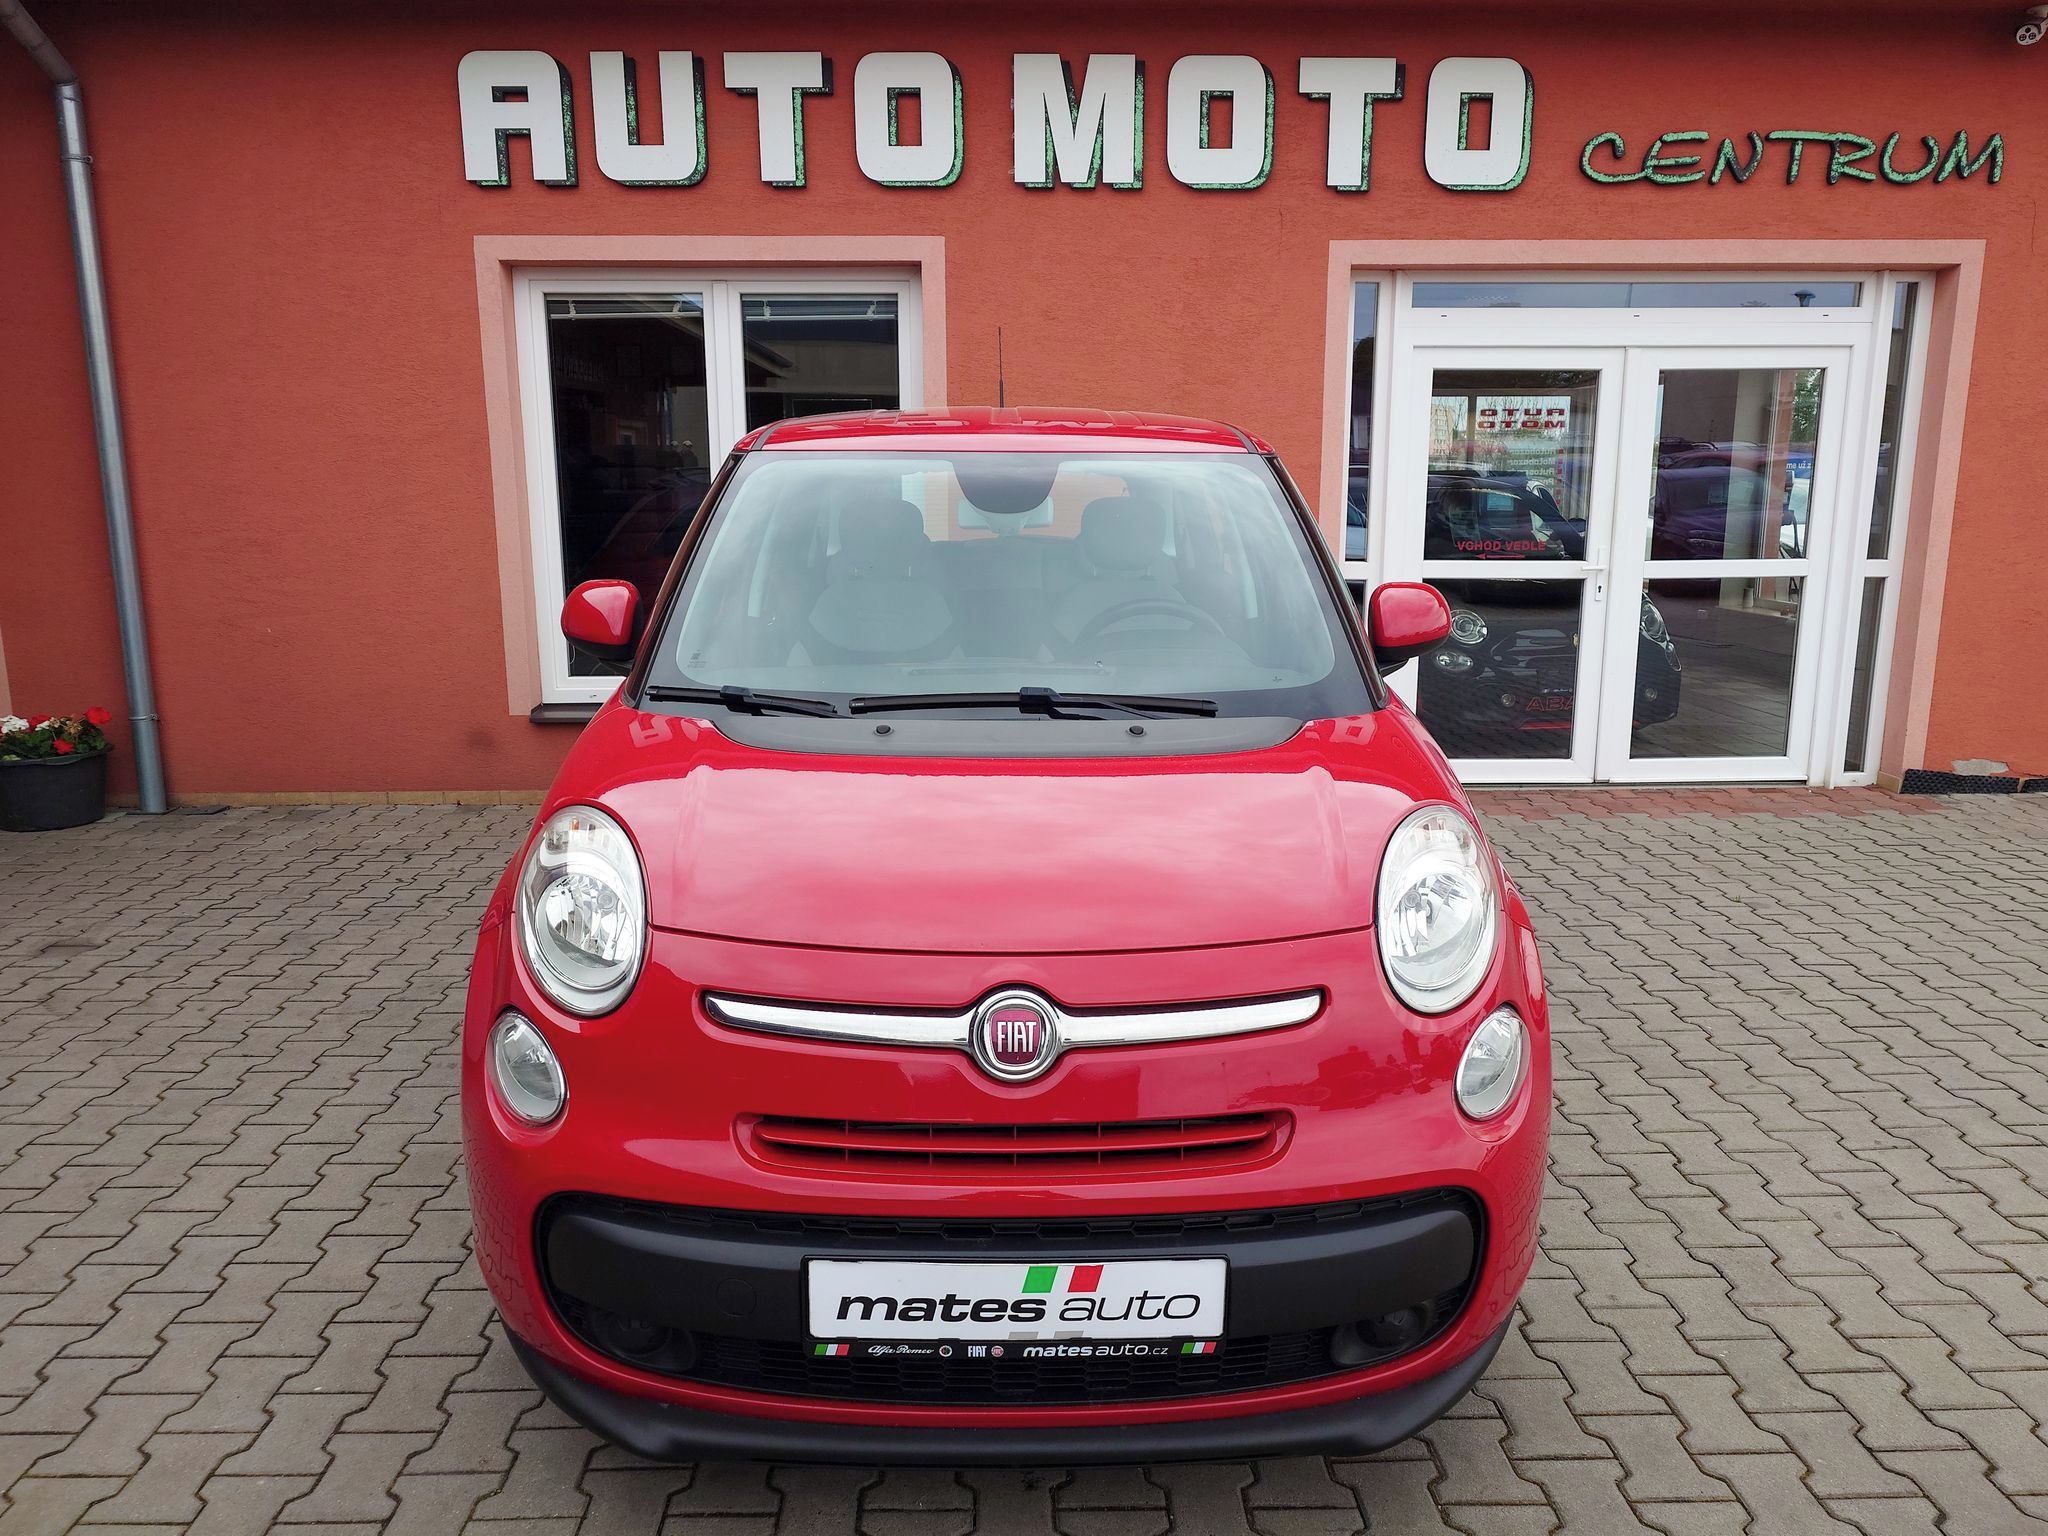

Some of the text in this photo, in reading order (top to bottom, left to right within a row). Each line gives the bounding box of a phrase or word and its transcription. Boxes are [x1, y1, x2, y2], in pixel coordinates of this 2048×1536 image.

[458, 50, 2004, 192] AUTO MOTO CENTRUM
[1505, 540, 1546, 551] VEDLE
[997, 1021, 1037, 1053] FIAT
[836, 1290, 1201, 1322] mates auto
[867, 1344, 896, 1357] Alfa
[895, 1344, 934, 1355] Romeo
[967, 1345, 987, 1358] FIAT
